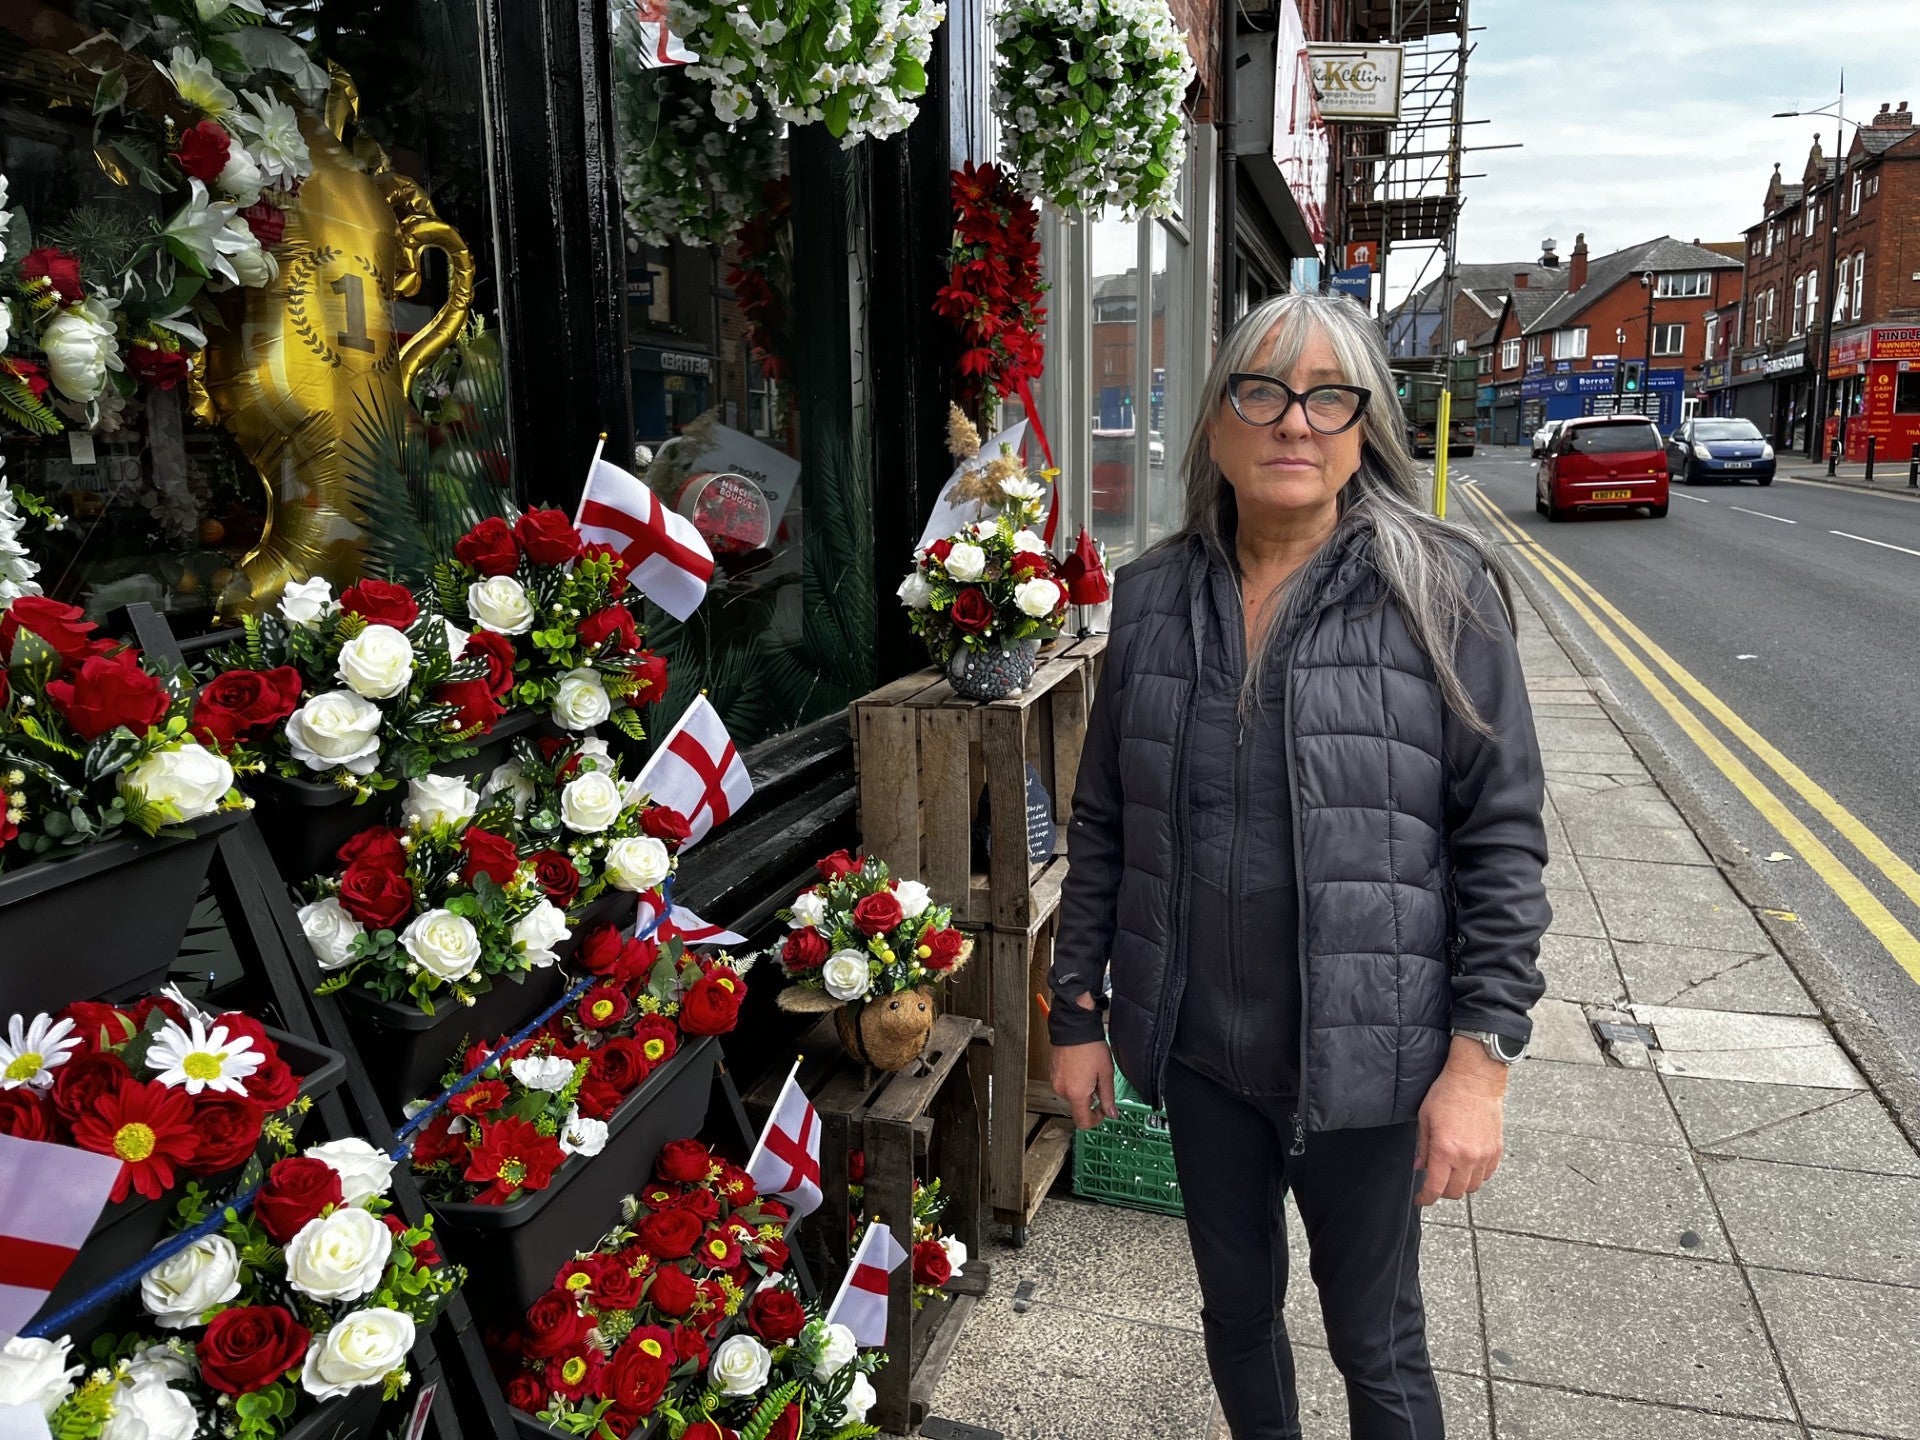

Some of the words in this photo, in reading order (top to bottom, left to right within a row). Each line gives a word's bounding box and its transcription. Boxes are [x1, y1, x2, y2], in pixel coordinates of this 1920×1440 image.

[1312, 68, 1334, 84] Kay
[1341, 69, 1386, 83] Collins
[1322, 61, 1378, 92] KC
[330, 273, 375, 354] 1
[1580, 377, 1610, 385] Borron
[719, 487, 758, 512] BOUQUET
